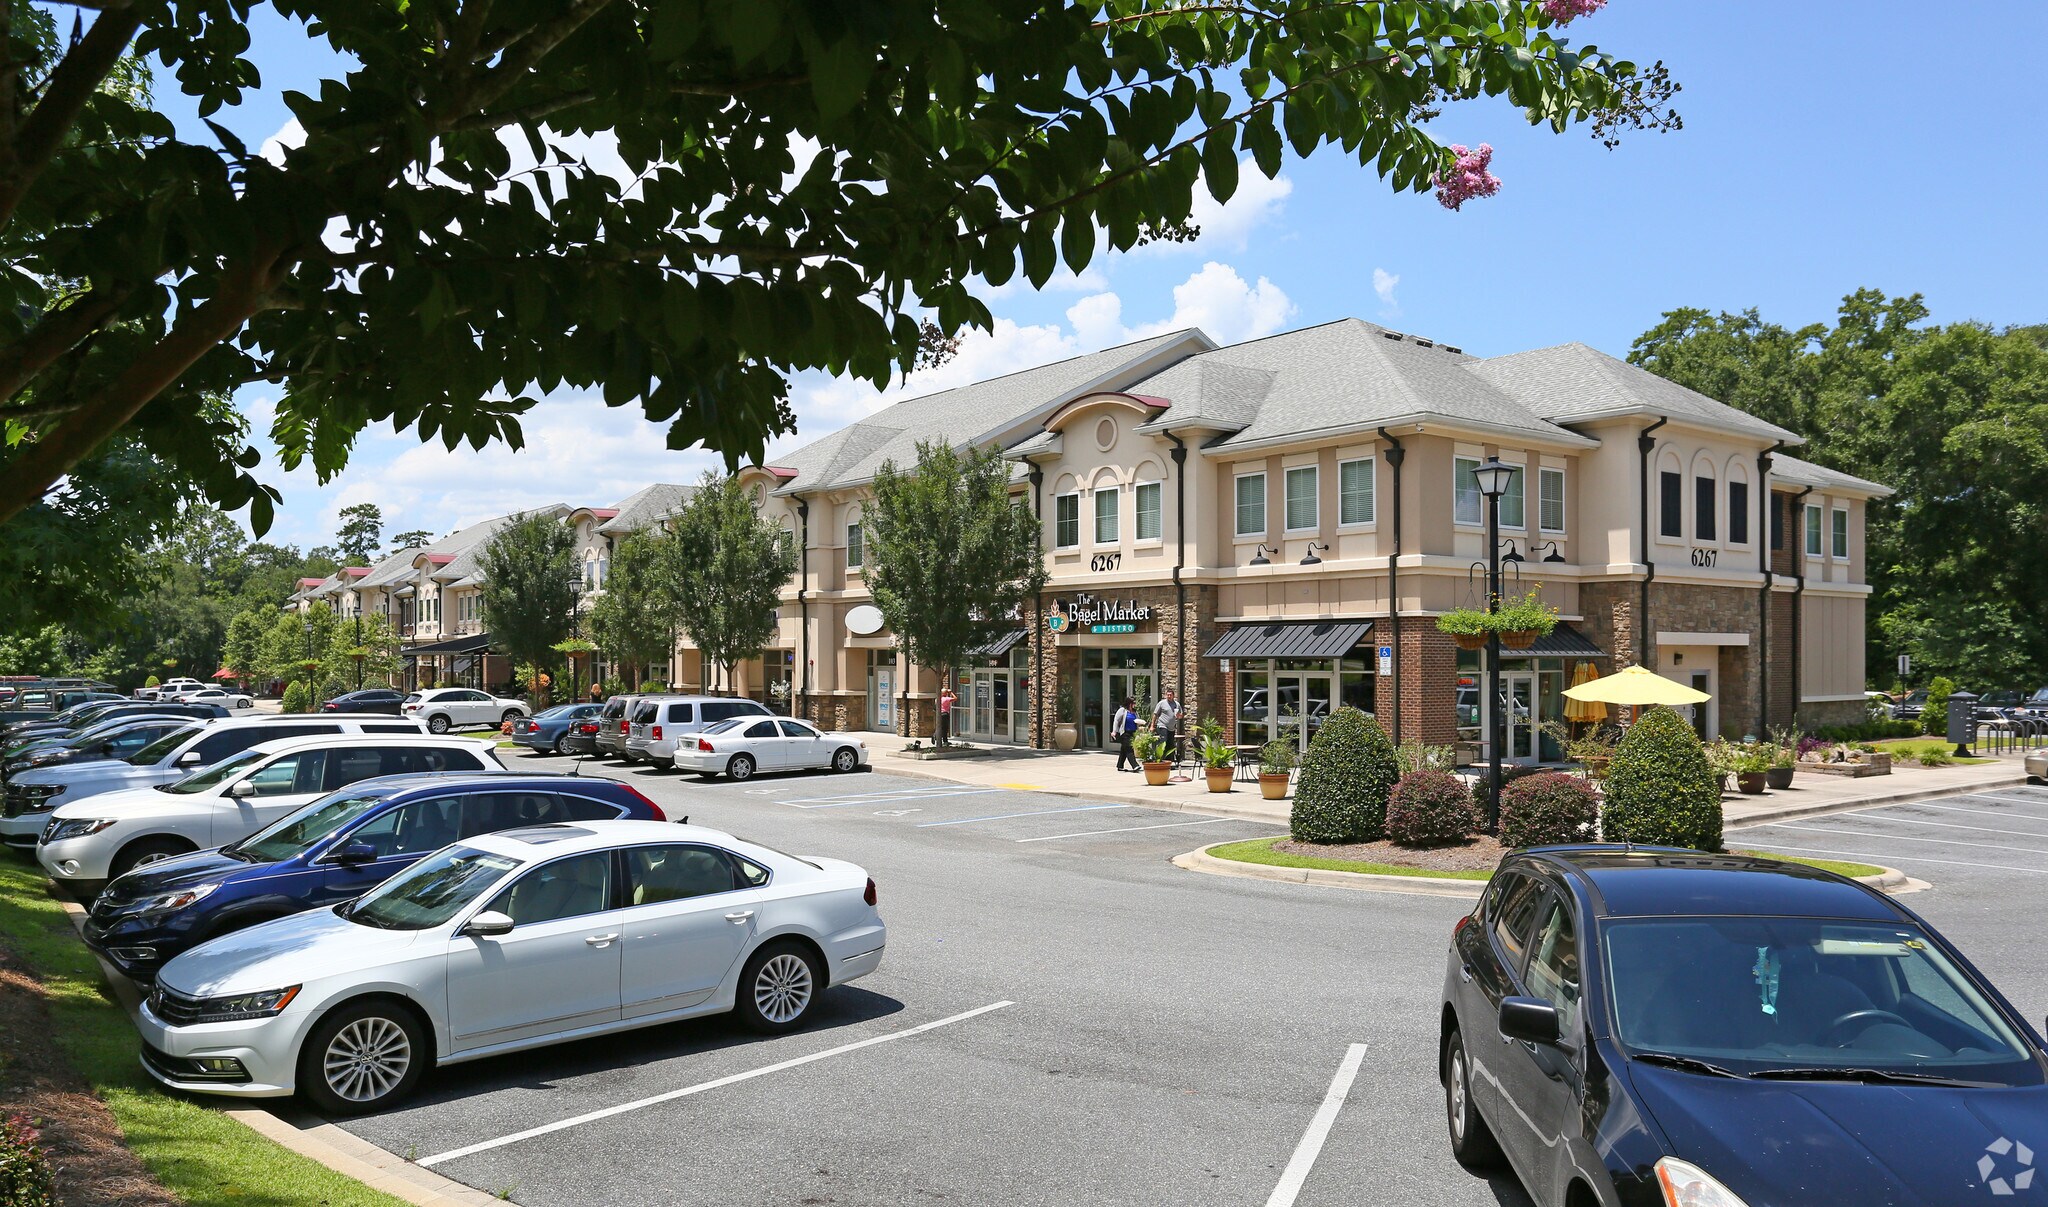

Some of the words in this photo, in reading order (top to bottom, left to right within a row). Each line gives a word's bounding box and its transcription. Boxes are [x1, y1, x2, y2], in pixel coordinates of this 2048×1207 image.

[1091, 554, 1121, 572] 6267
[1690, 548, 1717, 568] 6267
[1077, 593, 1091, 605] The
[1069, 601, 1100, 625] Bagel
[1103, 600, 1149, 621] Market
[1102, 624, 1133, 632] BISTRO
[1126, 659, 1137, 667] 105
